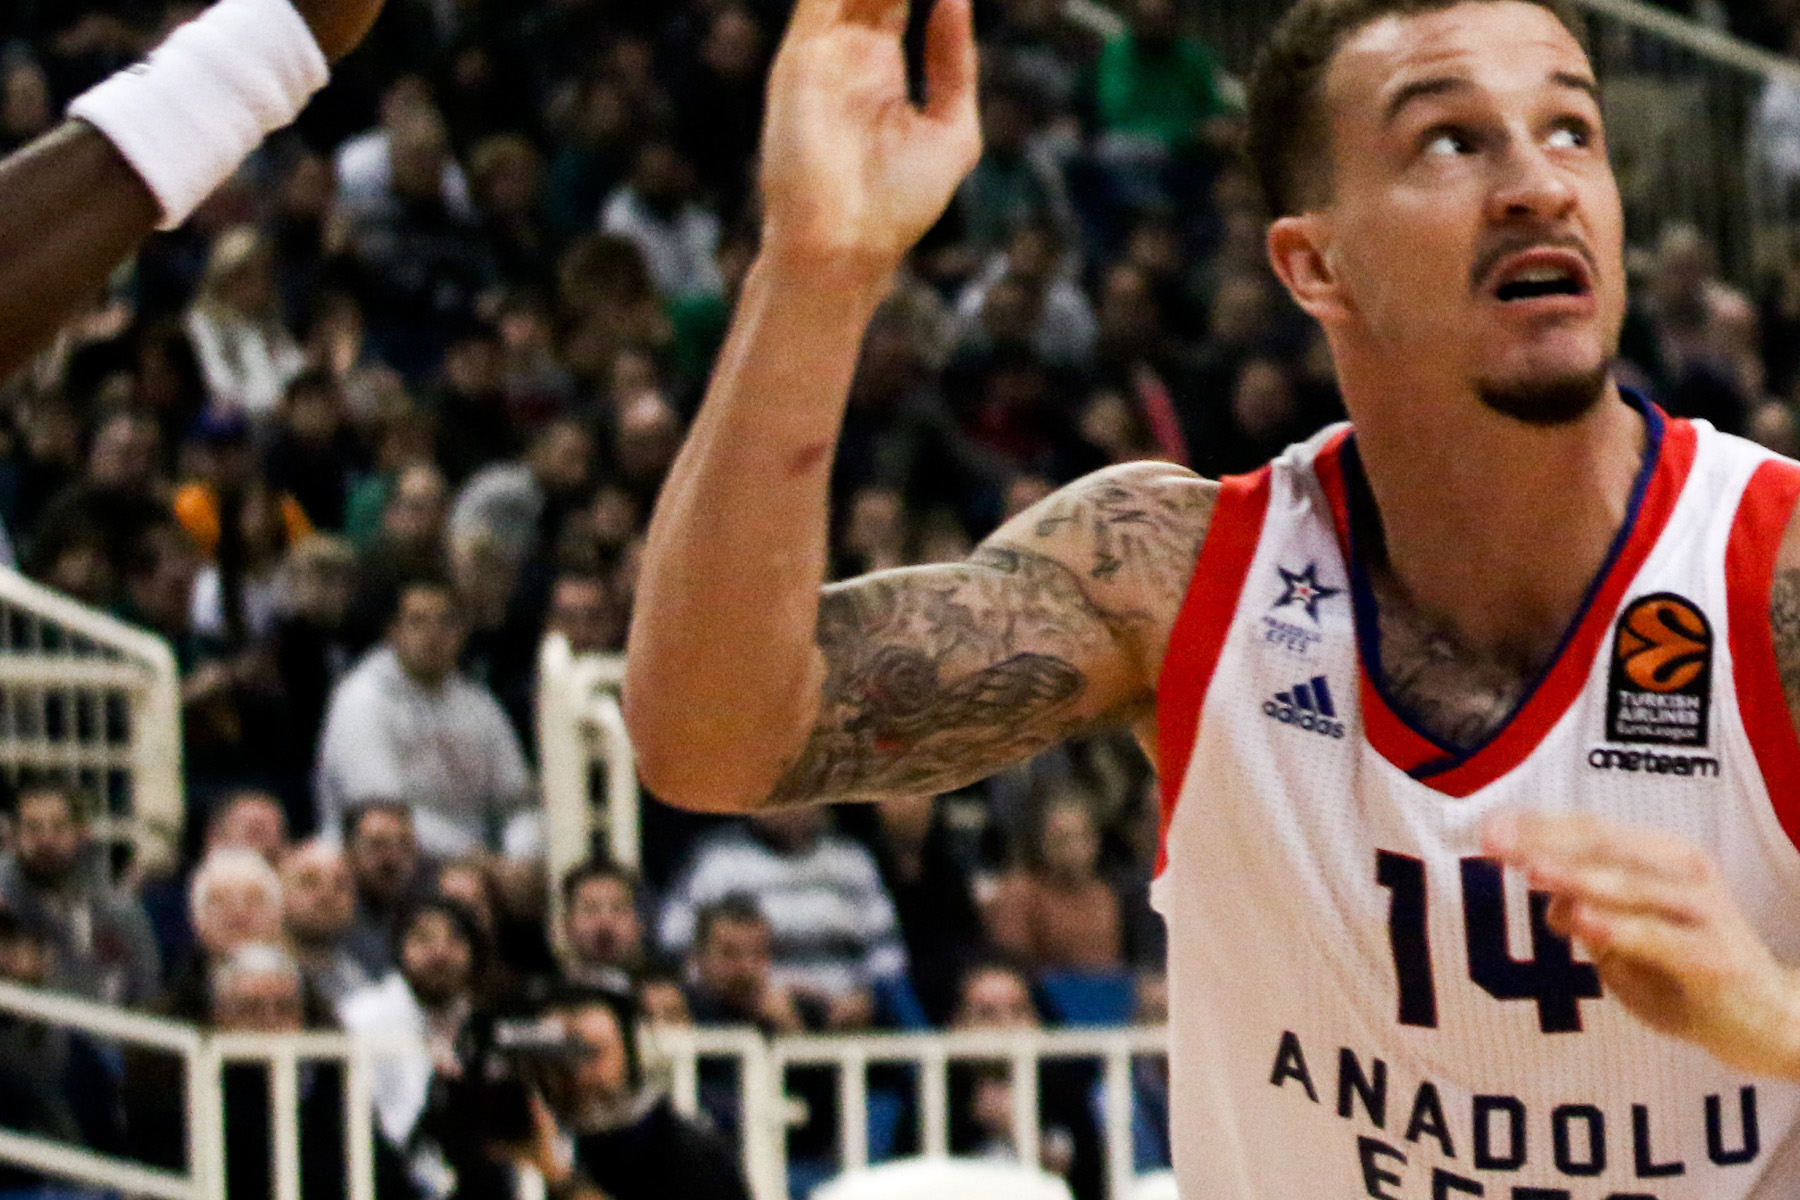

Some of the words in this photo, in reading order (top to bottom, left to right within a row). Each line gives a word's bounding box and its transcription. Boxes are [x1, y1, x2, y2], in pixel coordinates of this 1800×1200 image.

[1263, 700, 1344, 739] adidas
[1376, 848, 1603, 1033] 14
[1270, 1030, 1761, 1179] ANADOLU
